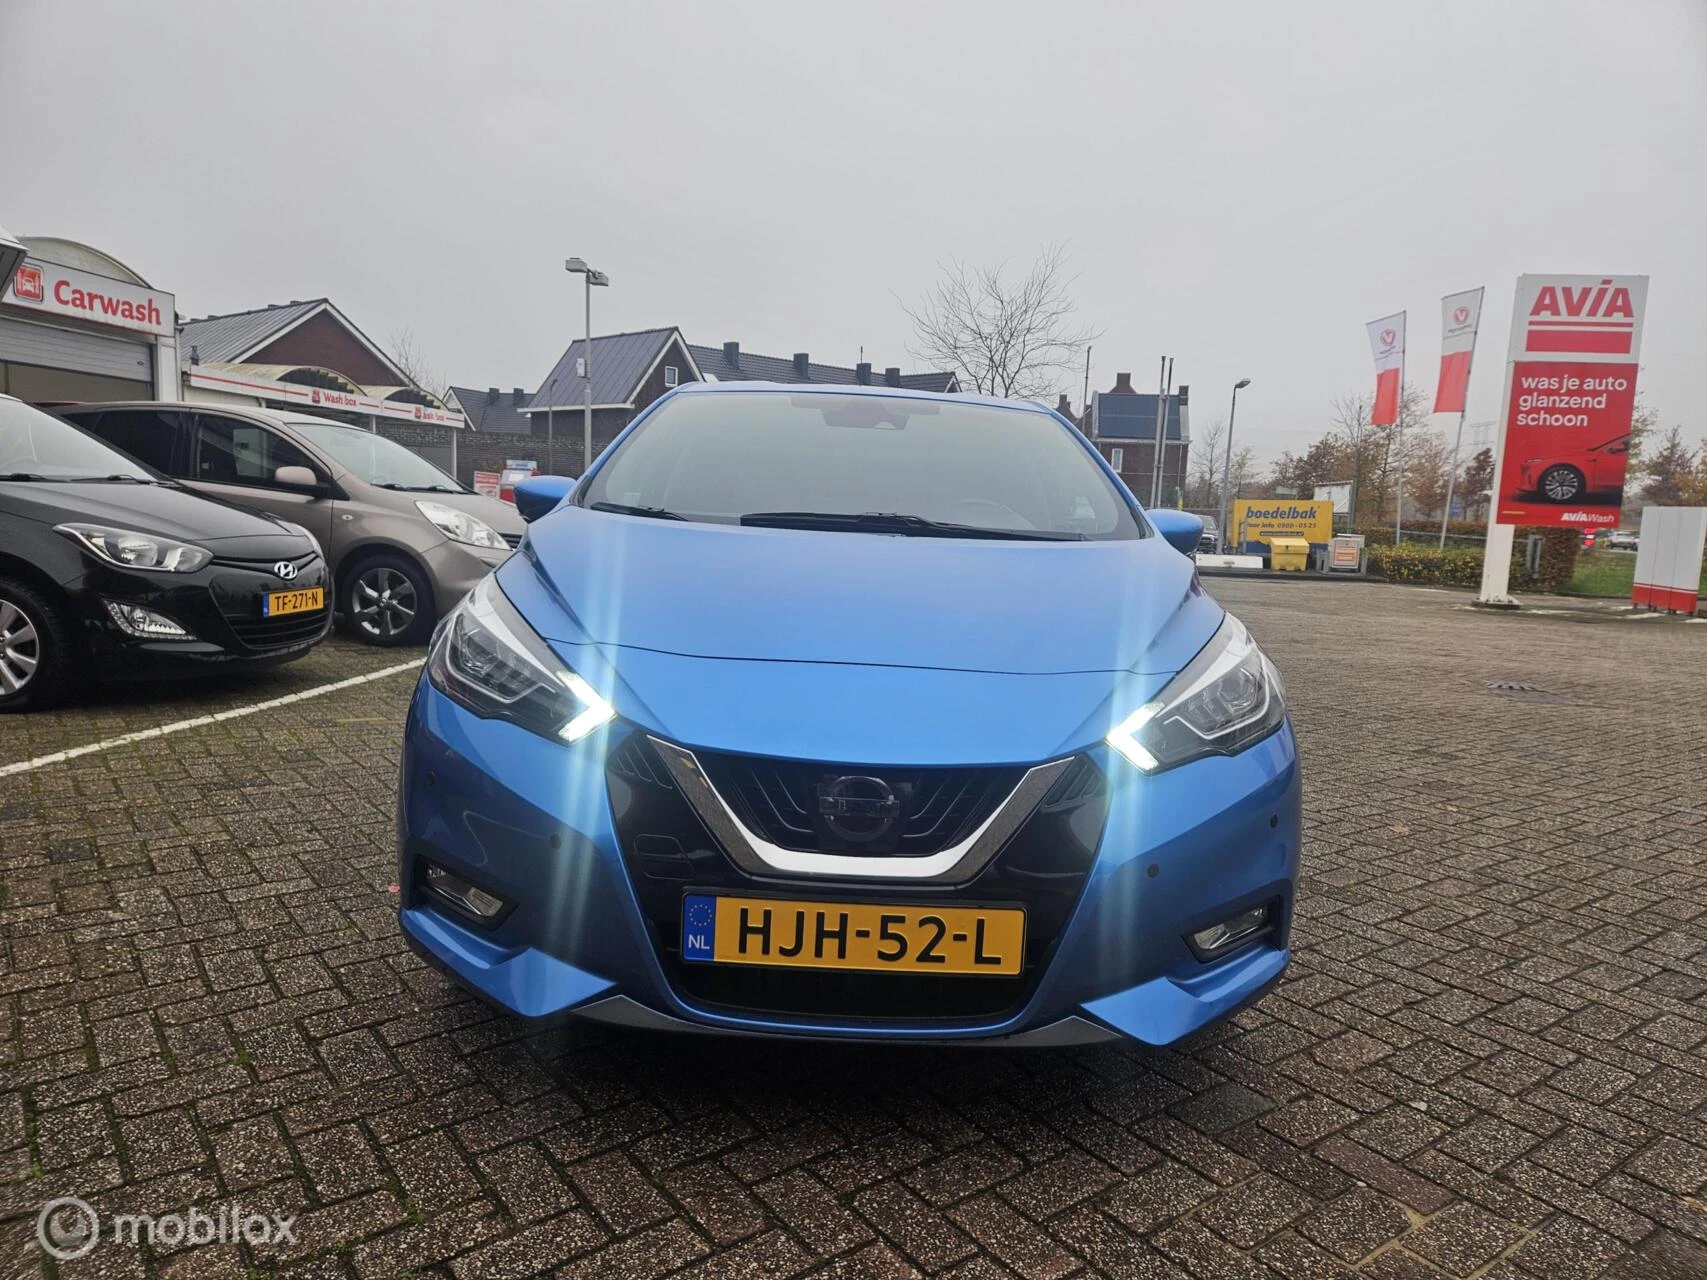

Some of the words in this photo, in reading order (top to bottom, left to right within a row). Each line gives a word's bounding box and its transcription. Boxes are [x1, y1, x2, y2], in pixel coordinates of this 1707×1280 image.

[53, 279, 162, 326] Carwash
[1521, 376, 1560, 389] was
[1560, 374, 1580, 392] je
[1583, 376, 1628, 391] auto
[323, 391, 343, 404] Wash
[344, 394, 357, 407] box
[1519, 392, 1607, 410] glanzend
[1516, 411, 1589, 427] schoon
[1246, 506, 1318, 519] boedelbak
[274, 591, 318, 612] TF-271-N
[688, 934, 710, 950] NL
[738, 907, 1002, 965] HJH-52-L
